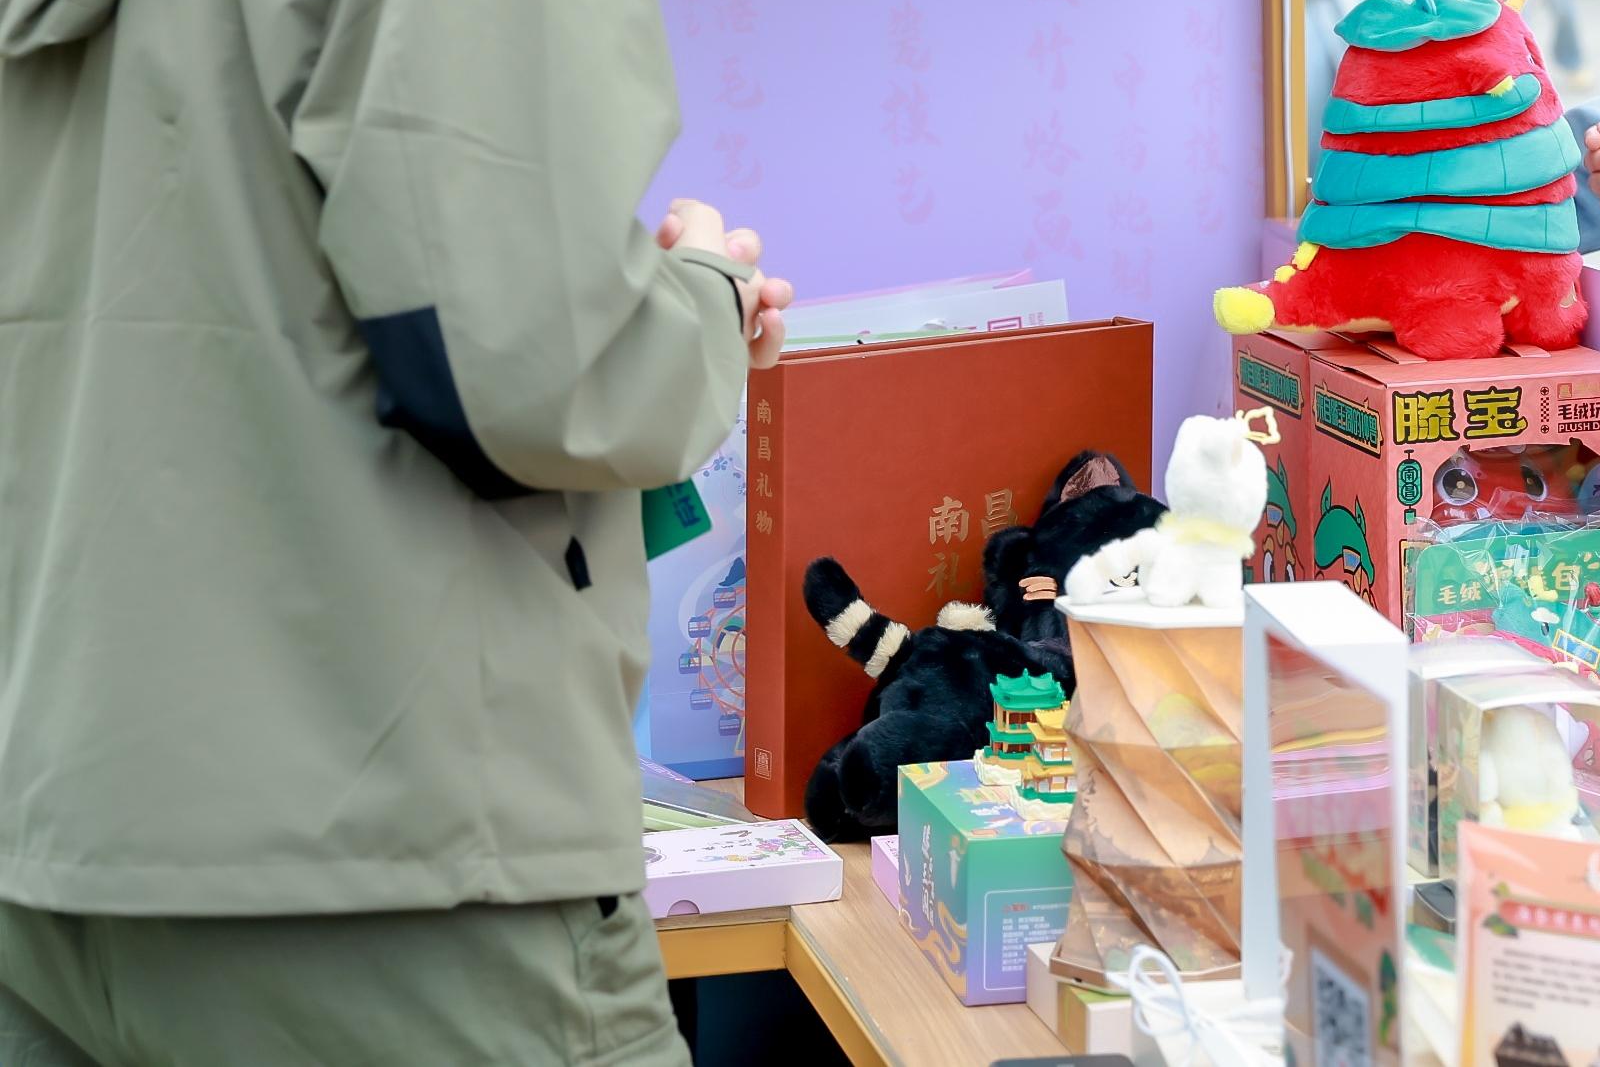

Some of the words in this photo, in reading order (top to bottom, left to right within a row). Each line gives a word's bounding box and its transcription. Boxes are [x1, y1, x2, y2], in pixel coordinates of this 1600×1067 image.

[1558, 422, 1590, 432] PLUSH
[755, 398, 773, 535] 南昌礼物
[928, 488, 1018, 545] 南昌
